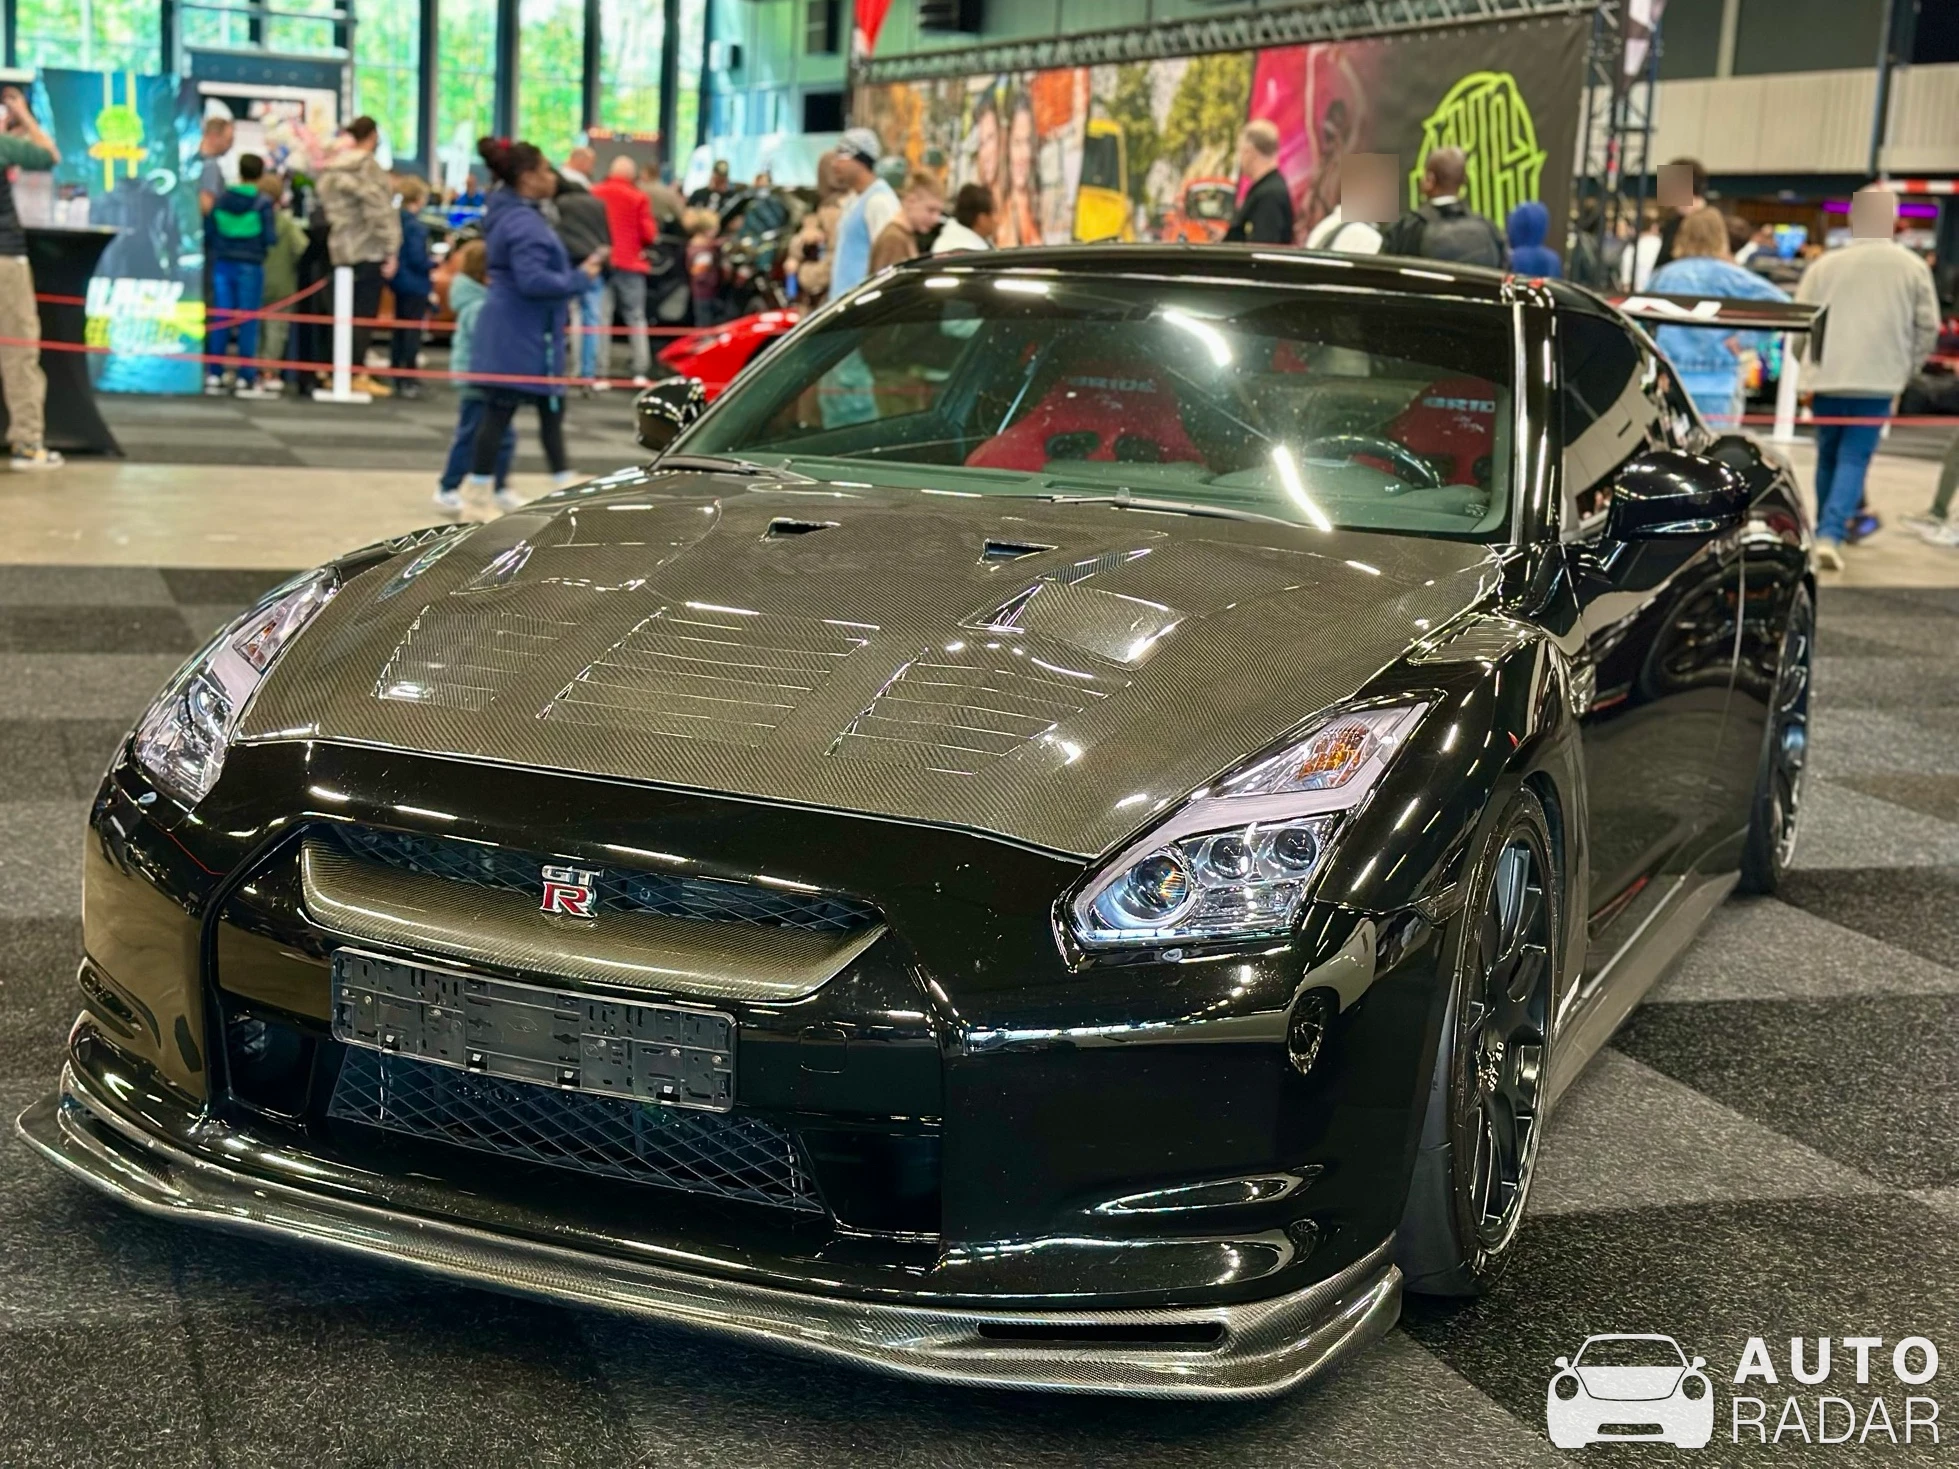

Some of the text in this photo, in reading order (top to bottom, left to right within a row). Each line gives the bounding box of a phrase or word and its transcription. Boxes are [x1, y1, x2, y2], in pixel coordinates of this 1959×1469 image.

[1423, 397, 1495, 413] BRID
[542, 865, 600, 886] GT
[539, 881, 596, 918] R
